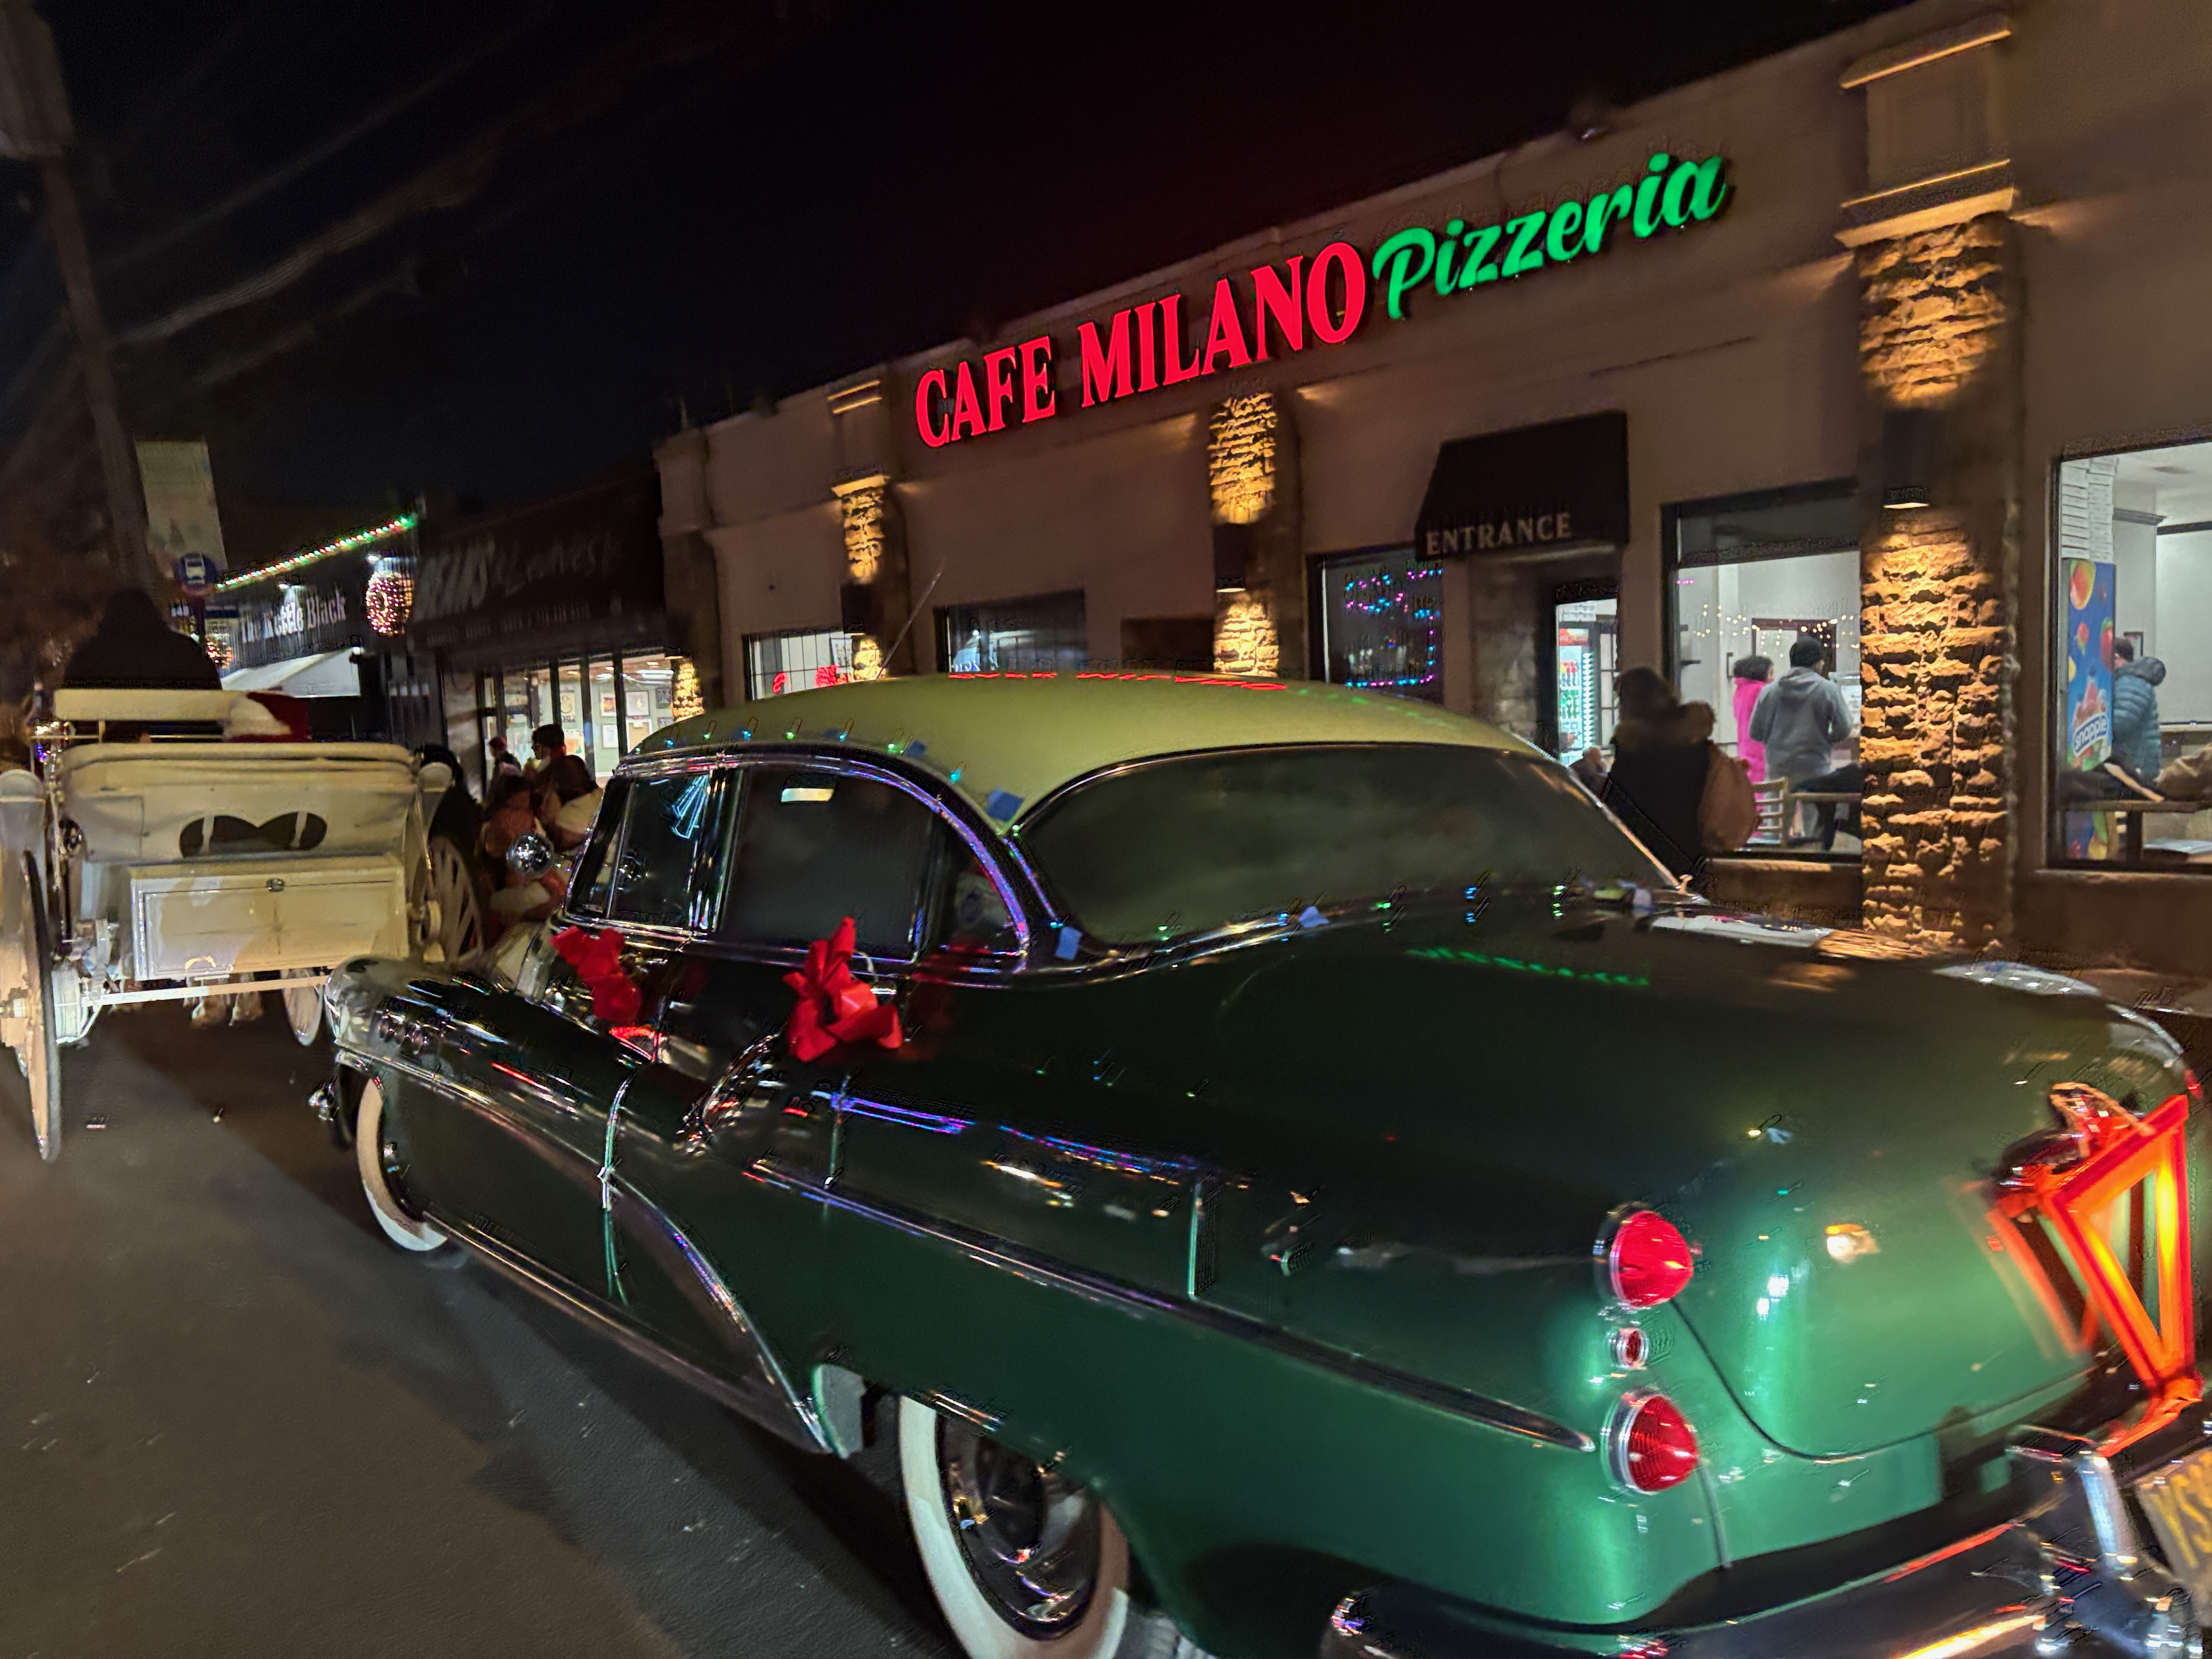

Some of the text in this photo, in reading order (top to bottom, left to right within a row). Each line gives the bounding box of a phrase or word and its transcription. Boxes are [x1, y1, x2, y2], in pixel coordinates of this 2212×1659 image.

[1373, 154, 1725, 318] Pizzeria
[916, 242, 1365, 447] CAFE MILANO
[1426, 512, 1572, 555] ENTRANCE
[306, 588, 346, 629] Black
